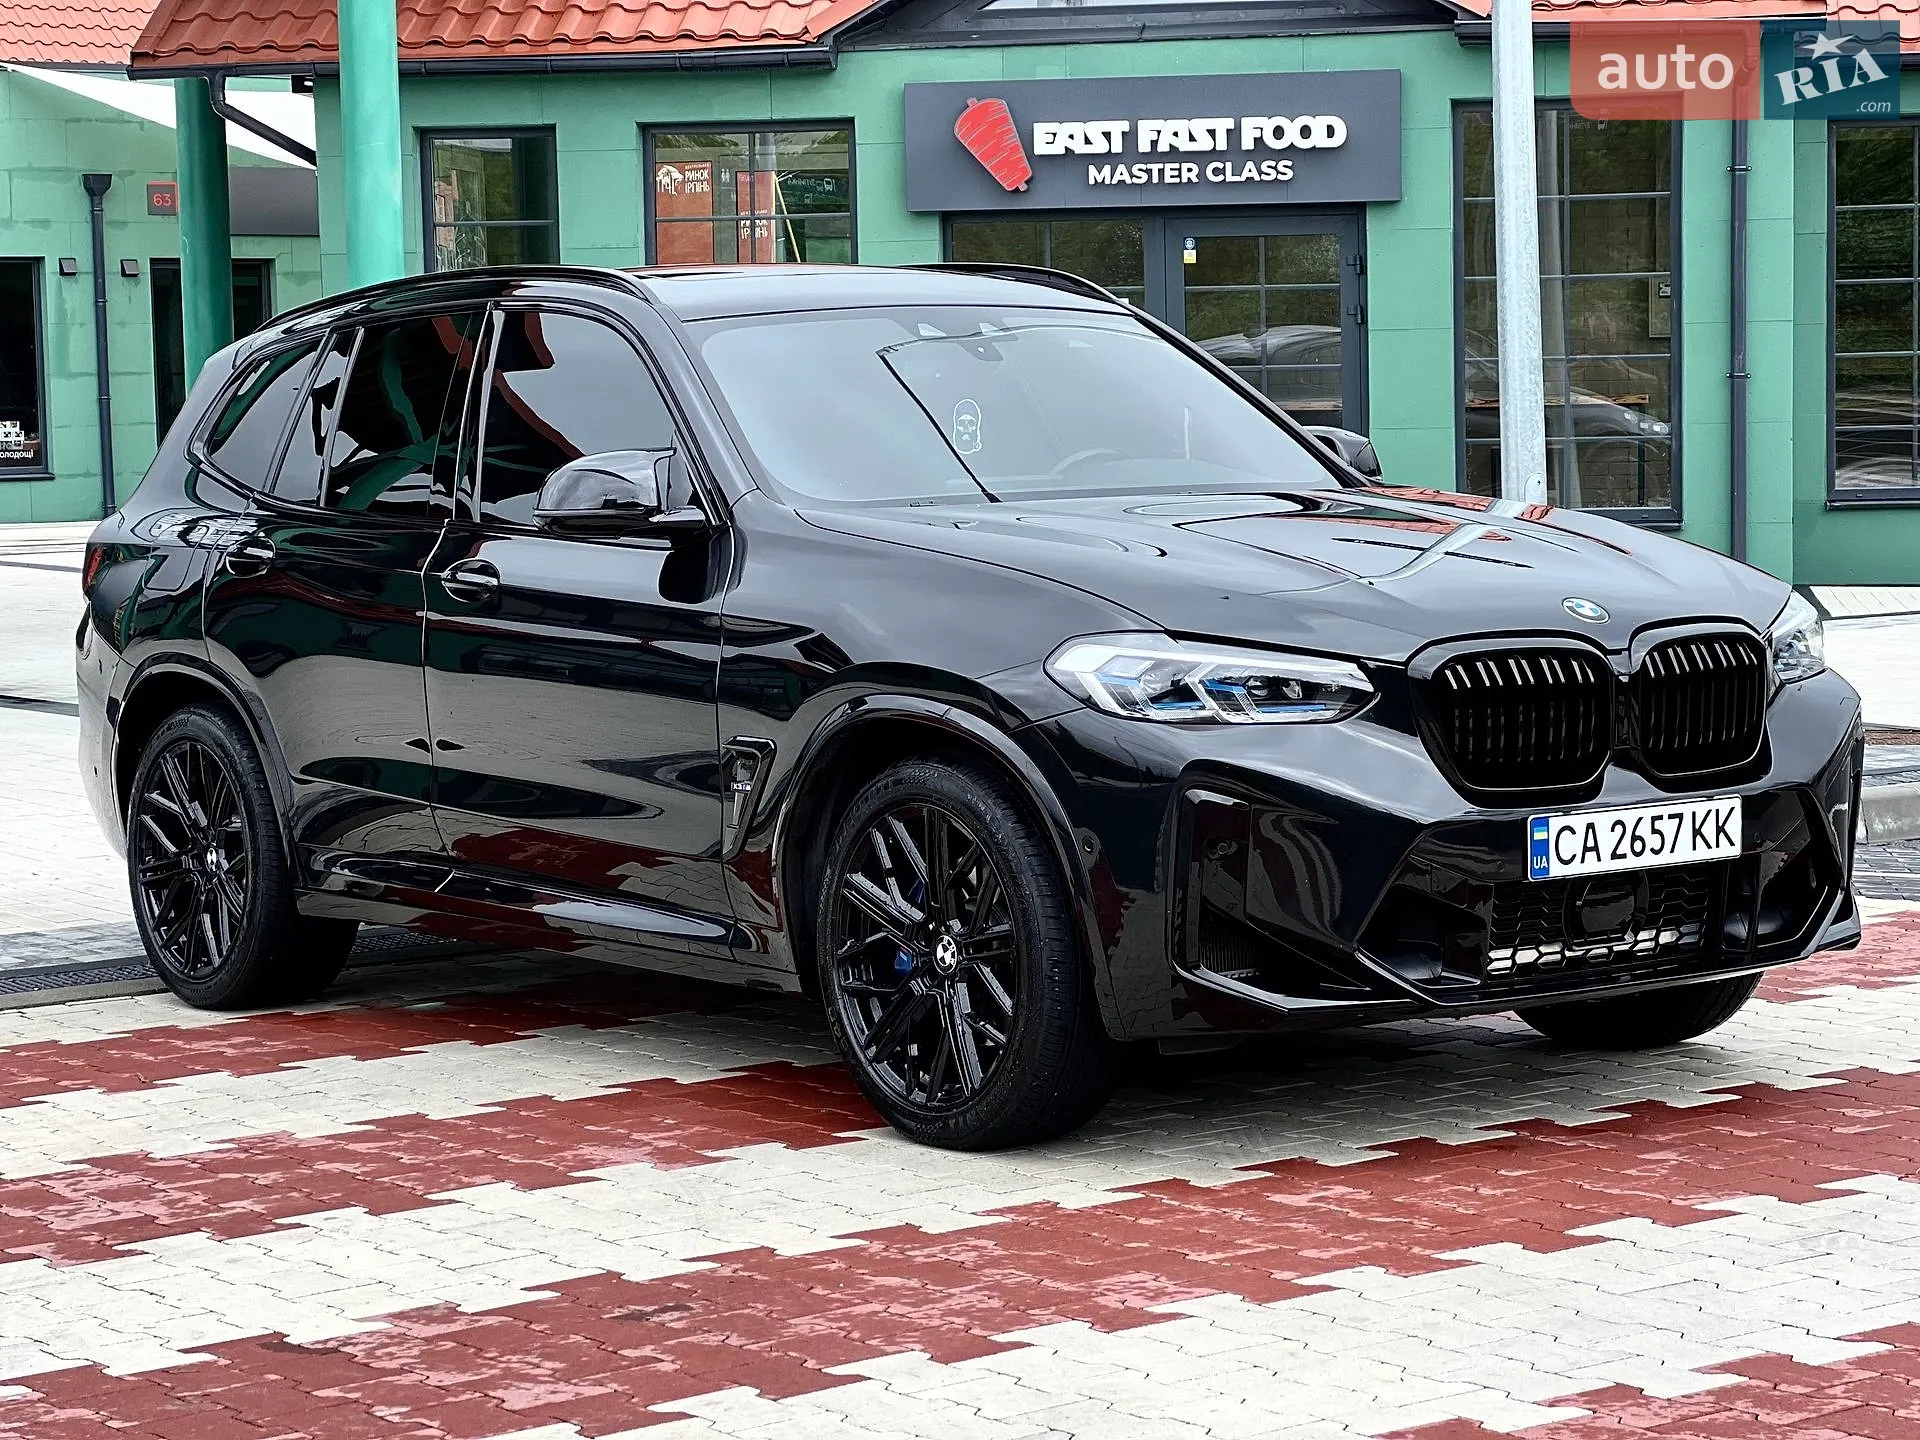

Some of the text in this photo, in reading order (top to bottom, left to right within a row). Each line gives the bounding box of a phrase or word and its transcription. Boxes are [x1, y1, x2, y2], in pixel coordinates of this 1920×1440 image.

[1033, 115, 1348, 155] EAST FAST FOOD
[1087, 159, 1294, 185] MASTER CLASS
[153, 193, 172, 207] 63
[0, 449, 34, 459] олодощі
[1554, 806, 1736, 866] CA 2657 KK
[1533, 855, 1549, 870] UA
